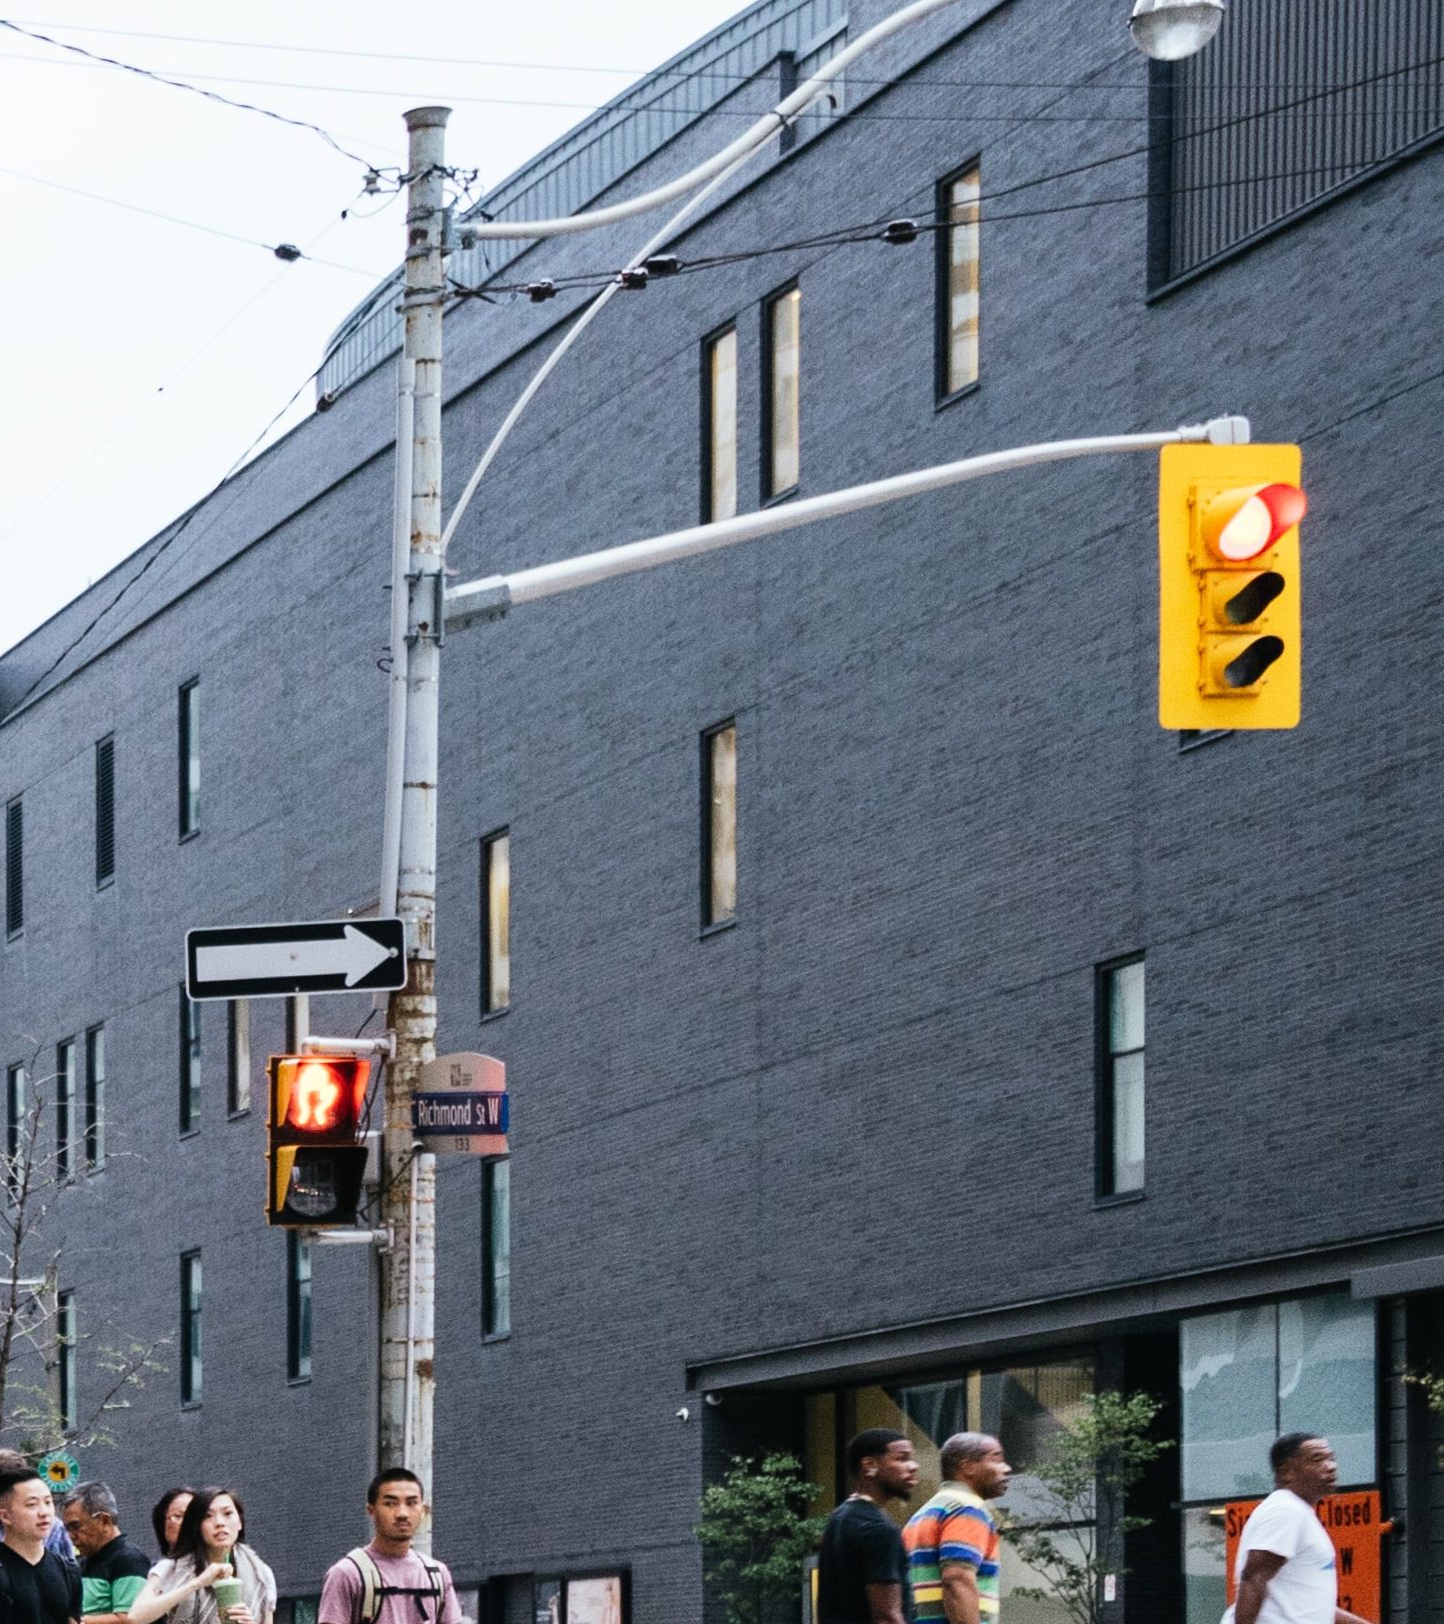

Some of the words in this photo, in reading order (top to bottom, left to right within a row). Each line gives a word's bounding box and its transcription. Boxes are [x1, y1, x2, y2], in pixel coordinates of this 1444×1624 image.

[418, 1099, 472, 1126] Richmond
[476, 1103, 486, 1125] St
[488, 1098, 499, 1124] W
[1316, 1496, 1371, 1527] Closed
